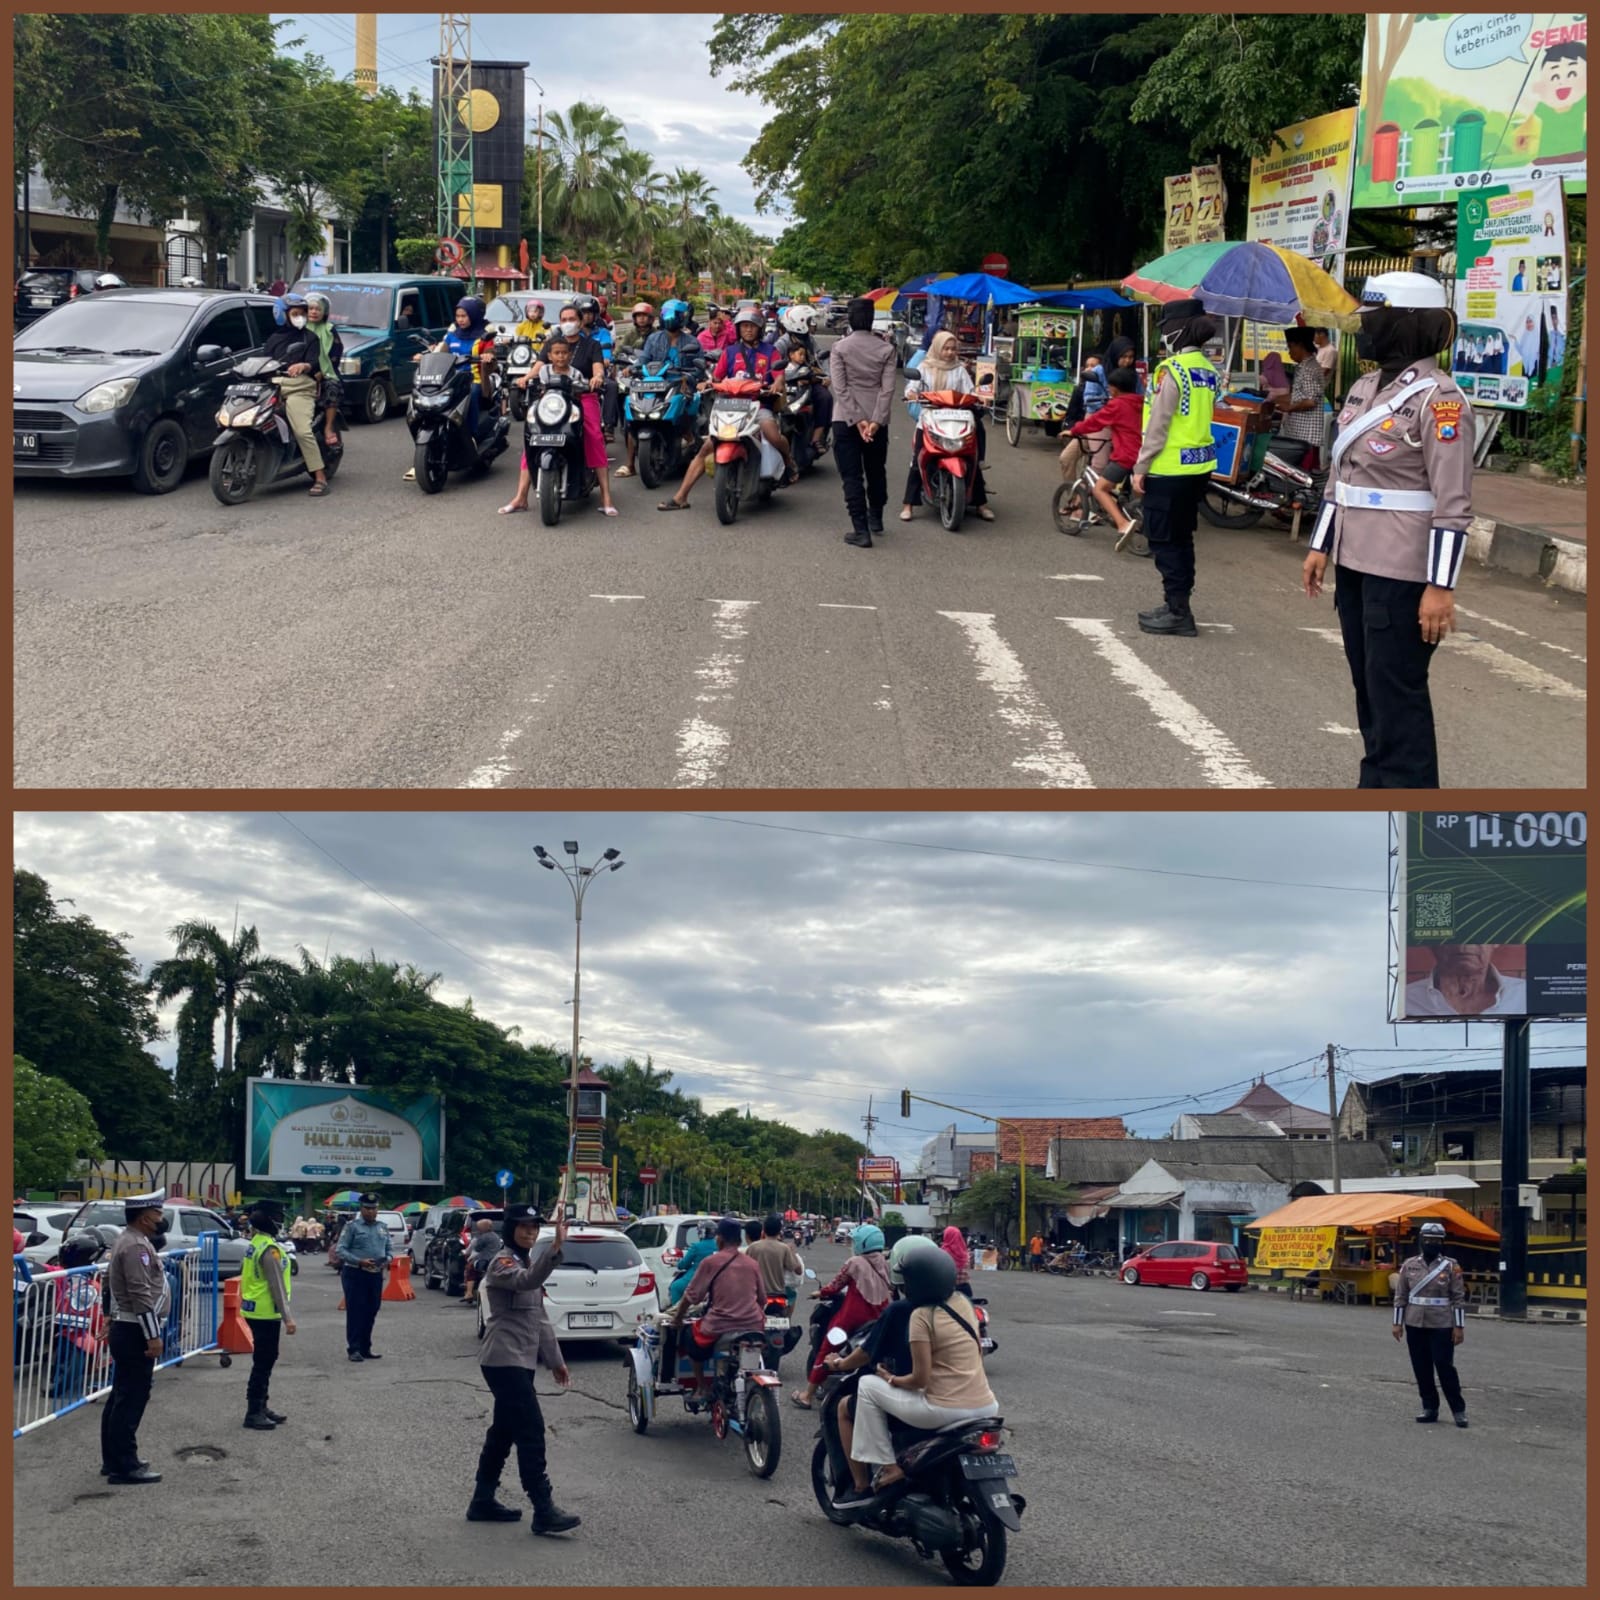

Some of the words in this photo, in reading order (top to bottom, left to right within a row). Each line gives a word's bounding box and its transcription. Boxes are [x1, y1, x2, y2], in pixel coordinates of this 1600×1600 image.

[1455, 24, 1521, 56] keberisihan
[1456, 25, 1483, 41] kami
[1436, 815, 1459, 829] RP
[1465, 811, 1587, 848] 14.000
[304, 1133, 344, 1147] HAUL
[345, 1134, 392, 1149] AKBAR
